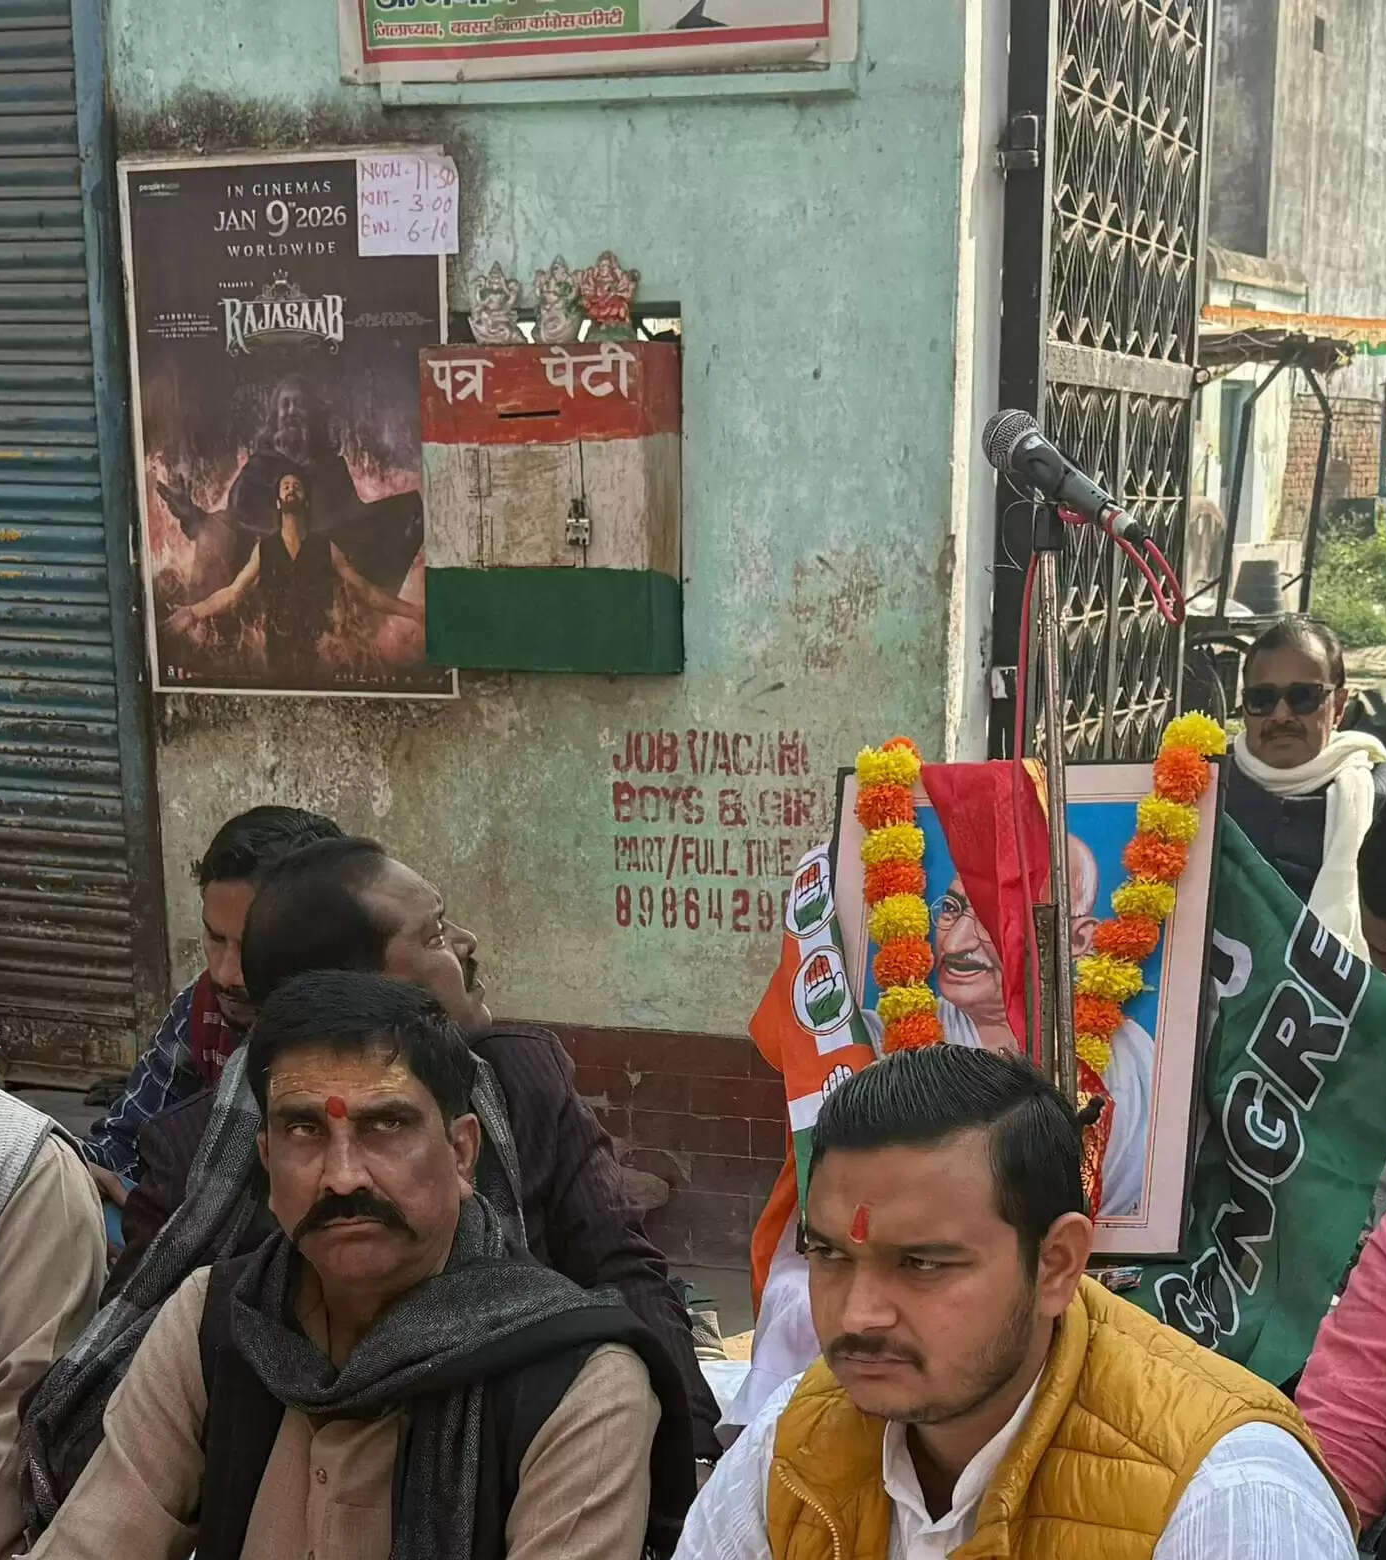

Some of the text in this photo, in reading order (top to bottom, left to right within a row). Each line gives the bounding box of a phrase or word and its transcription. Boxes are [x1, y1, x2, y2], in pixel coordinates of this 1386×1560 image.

[227, 180, 332, 198] IN CINEMAS
[213, 209, 257, 233] JAN
[295, 204, 347, 229] 2026
[227, 241, 337, 258] WORLDWIDE
[218, 294, 346, 356] RAJASAAB
[427, 342, 636, 405] पत्र पेटी
[613, 728, 679, 774] JOB
[612, 780, 705, 825] BOYS
[615, 884, 789, 933] 8986429
